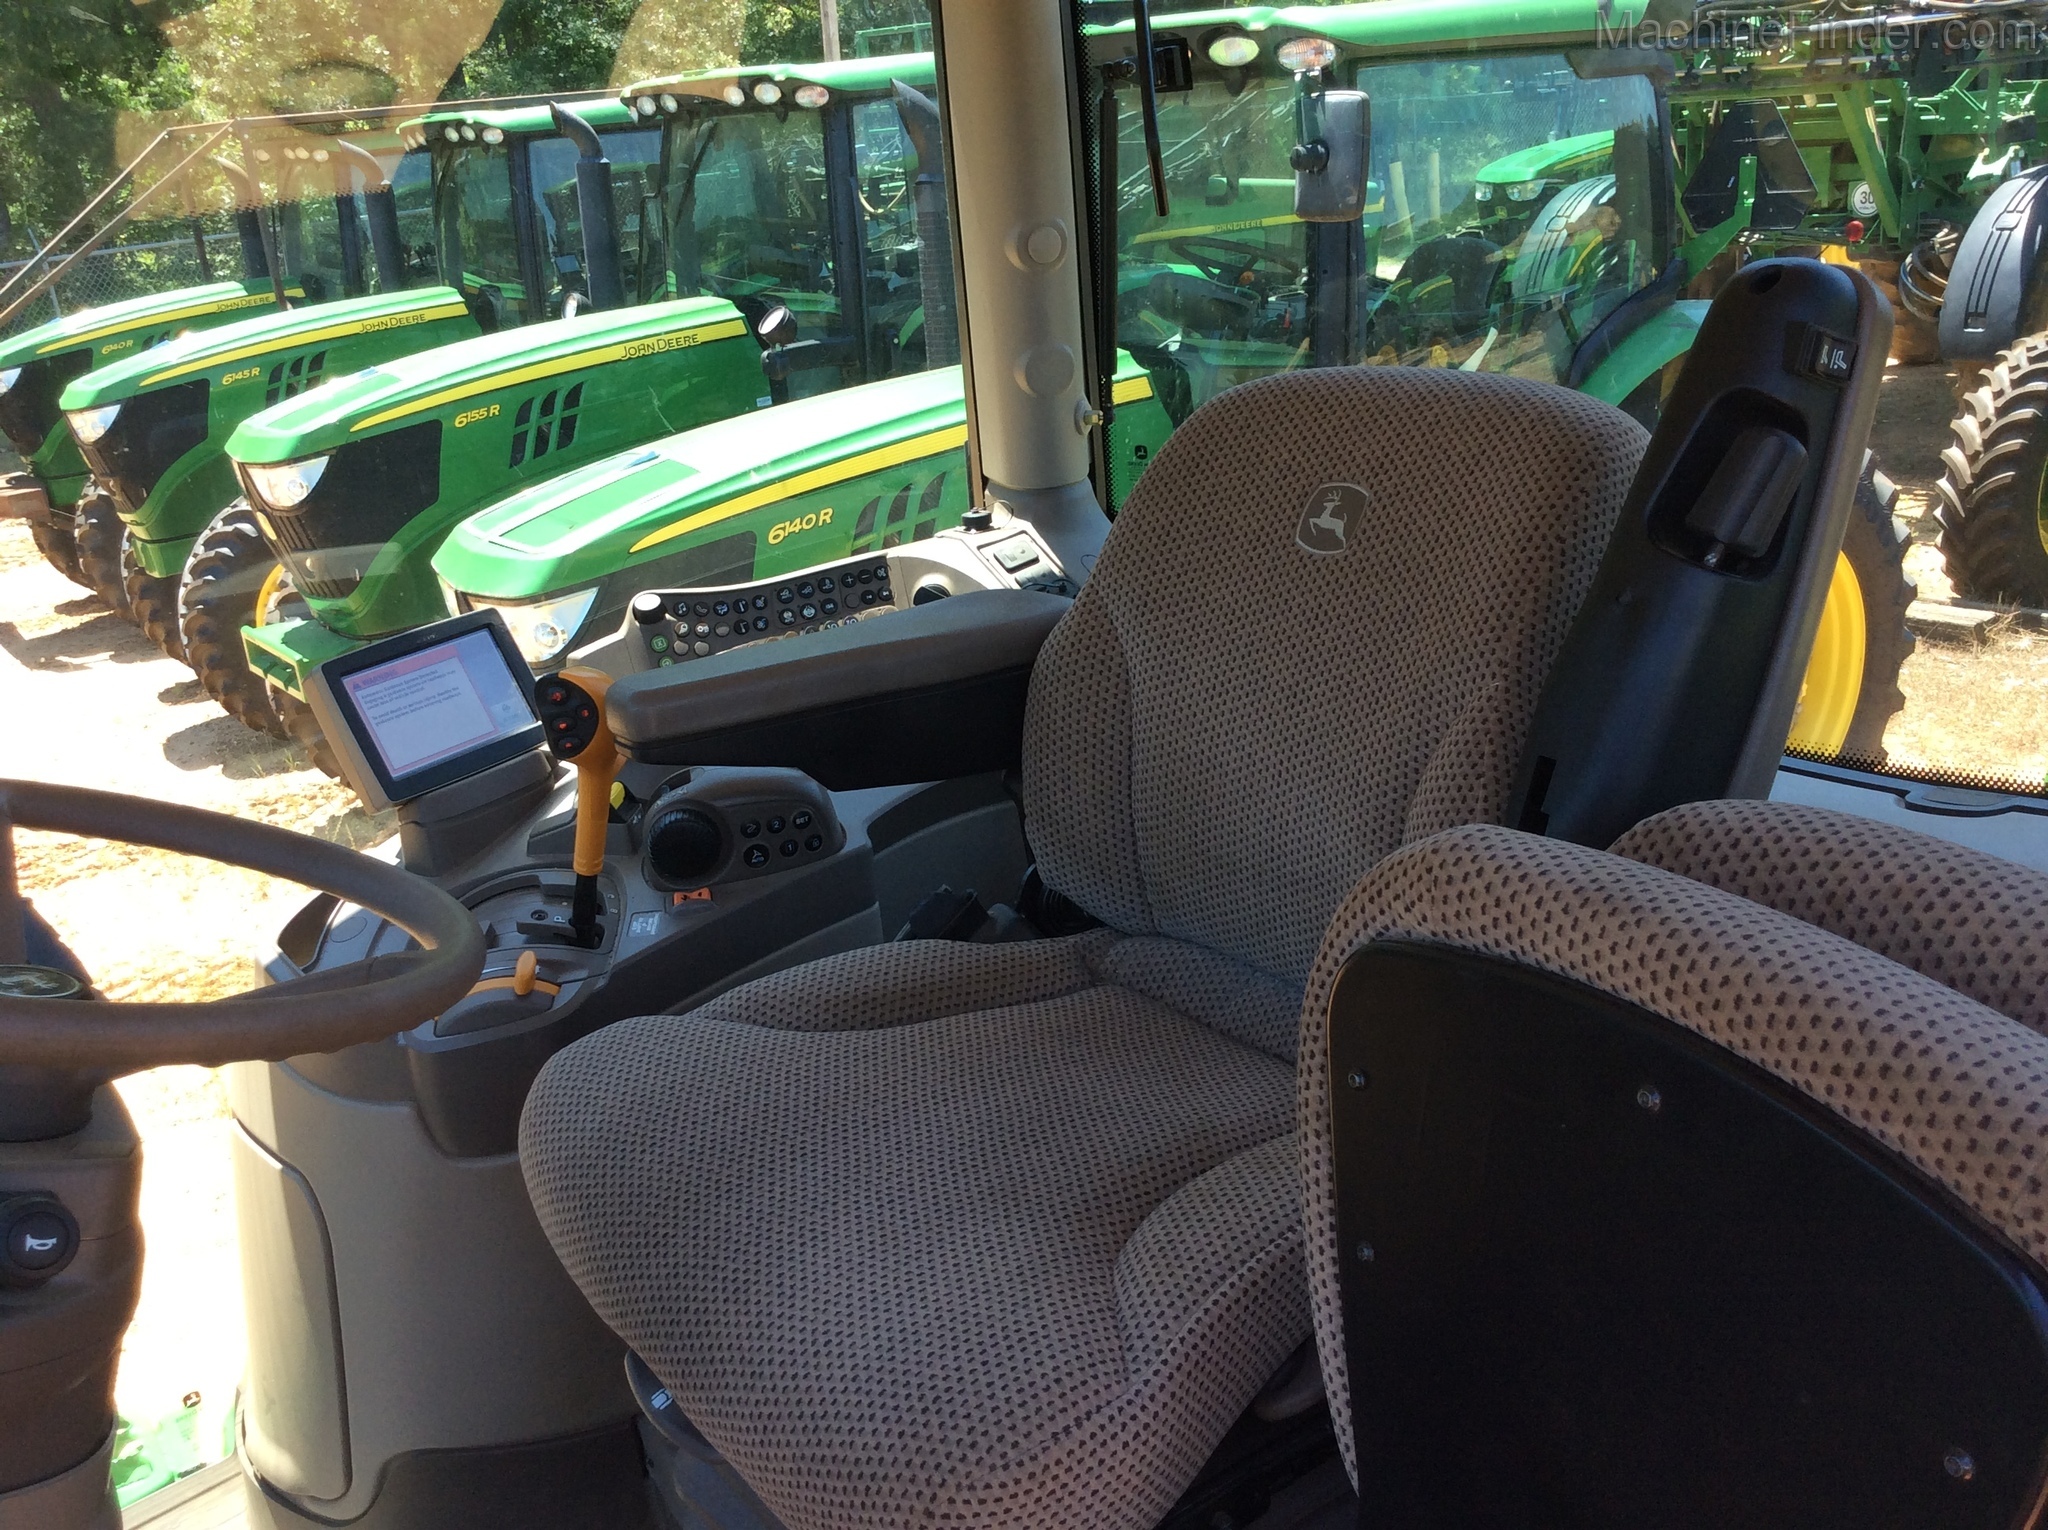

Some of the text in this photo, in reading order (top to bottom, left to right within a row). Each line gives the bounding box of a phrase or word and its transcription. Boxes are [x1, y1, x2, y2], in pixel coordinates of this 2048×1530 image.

[215, 296, 271, 312] JOHN DEERE
[359, 313, 427, 333] JOHN DEERE
[620, 333, 699, 359] JOHN DEERE
